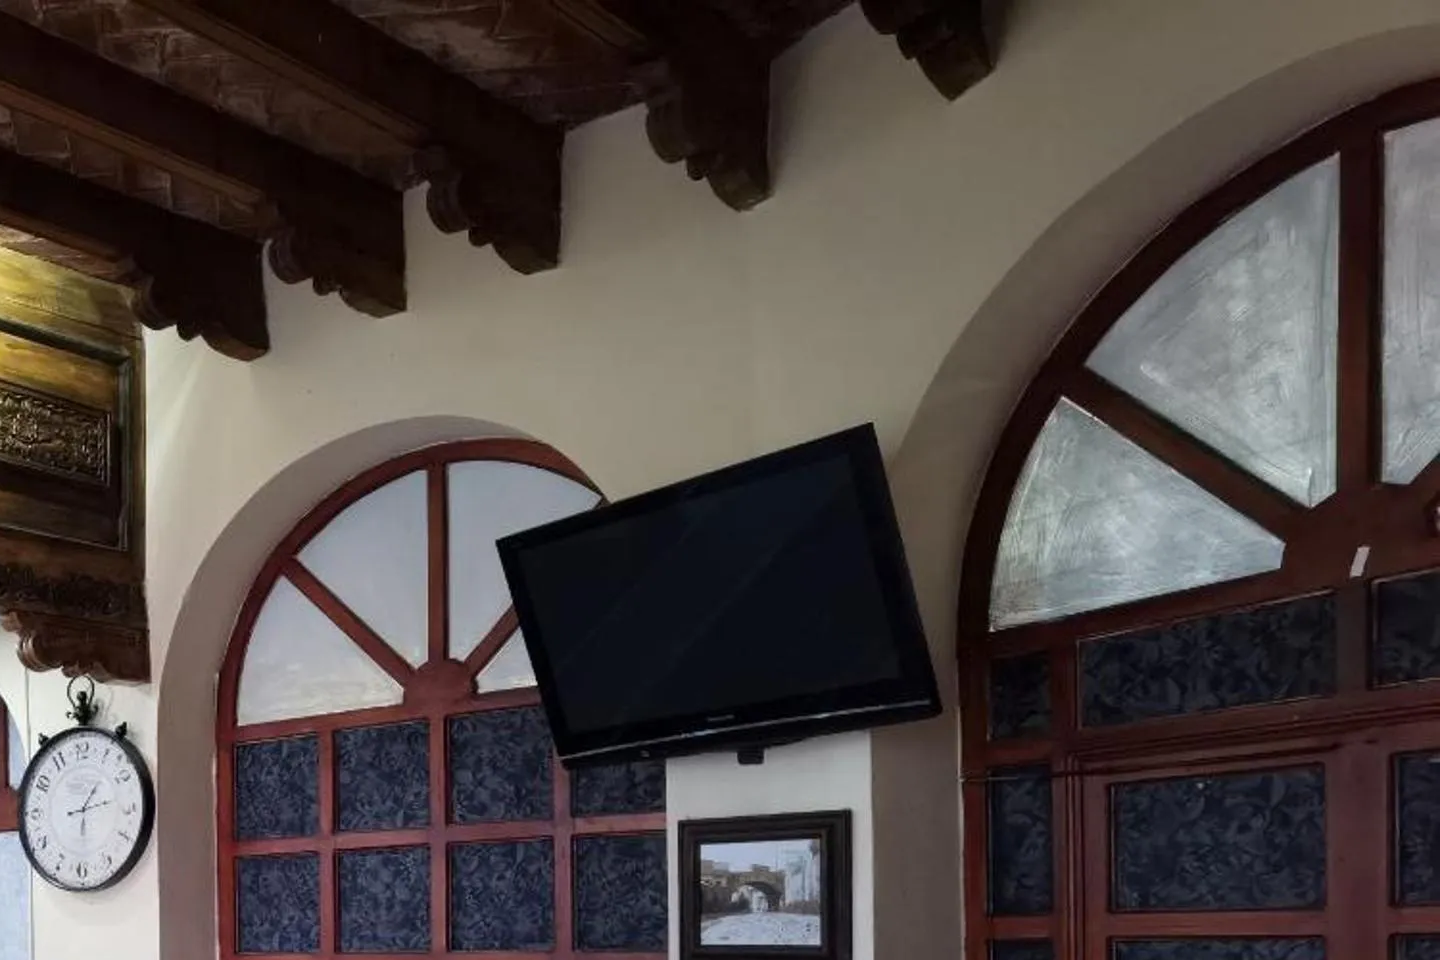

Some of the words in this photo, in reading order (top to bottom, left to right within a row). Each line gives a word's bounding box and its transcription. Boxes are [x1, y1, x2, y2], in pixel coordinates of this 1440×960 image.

[75, 741, 90, 761] 12
[101, 748, 110, 764] 1
[52, 751, 66, 771] 11
[36, 774, 50, 793] 10
[114, 769, 132, 784] 2
[30, 807, 44, 821] 9
[75, 862, 88, 878] 6
